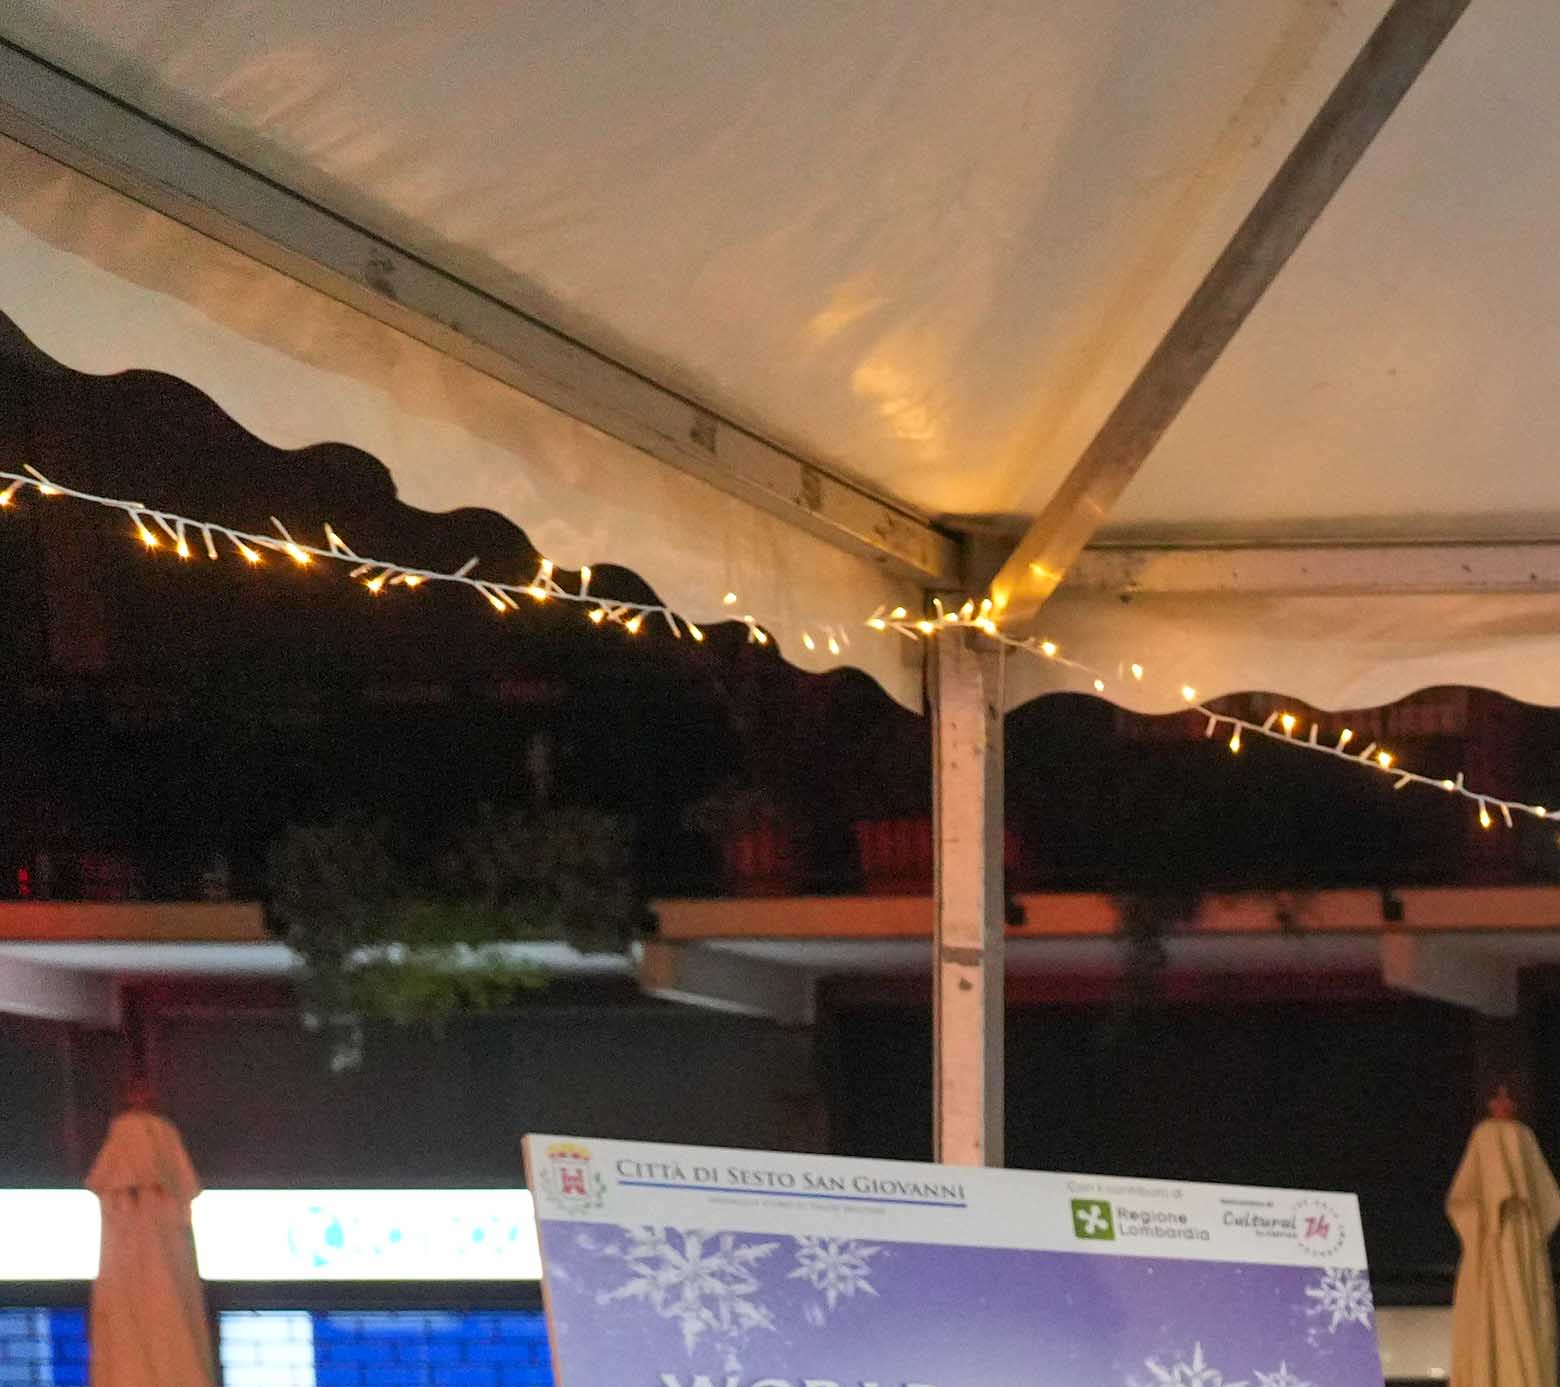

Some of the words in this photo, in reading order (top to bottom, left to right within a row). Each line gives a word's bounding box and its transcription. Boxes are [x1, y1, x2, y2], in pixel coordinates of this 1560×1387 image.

[693, 1166, 719, 1183] DI
[726, 1167, 796, 1189] SESTO
[803, 1171, 847, 1191] SAN
[854, 1175, 967, 1201] GIOVANNI
[1117, 1207, 1187, 1226] Regione
[1119, 1223, 1210, 1241] Lombardia
